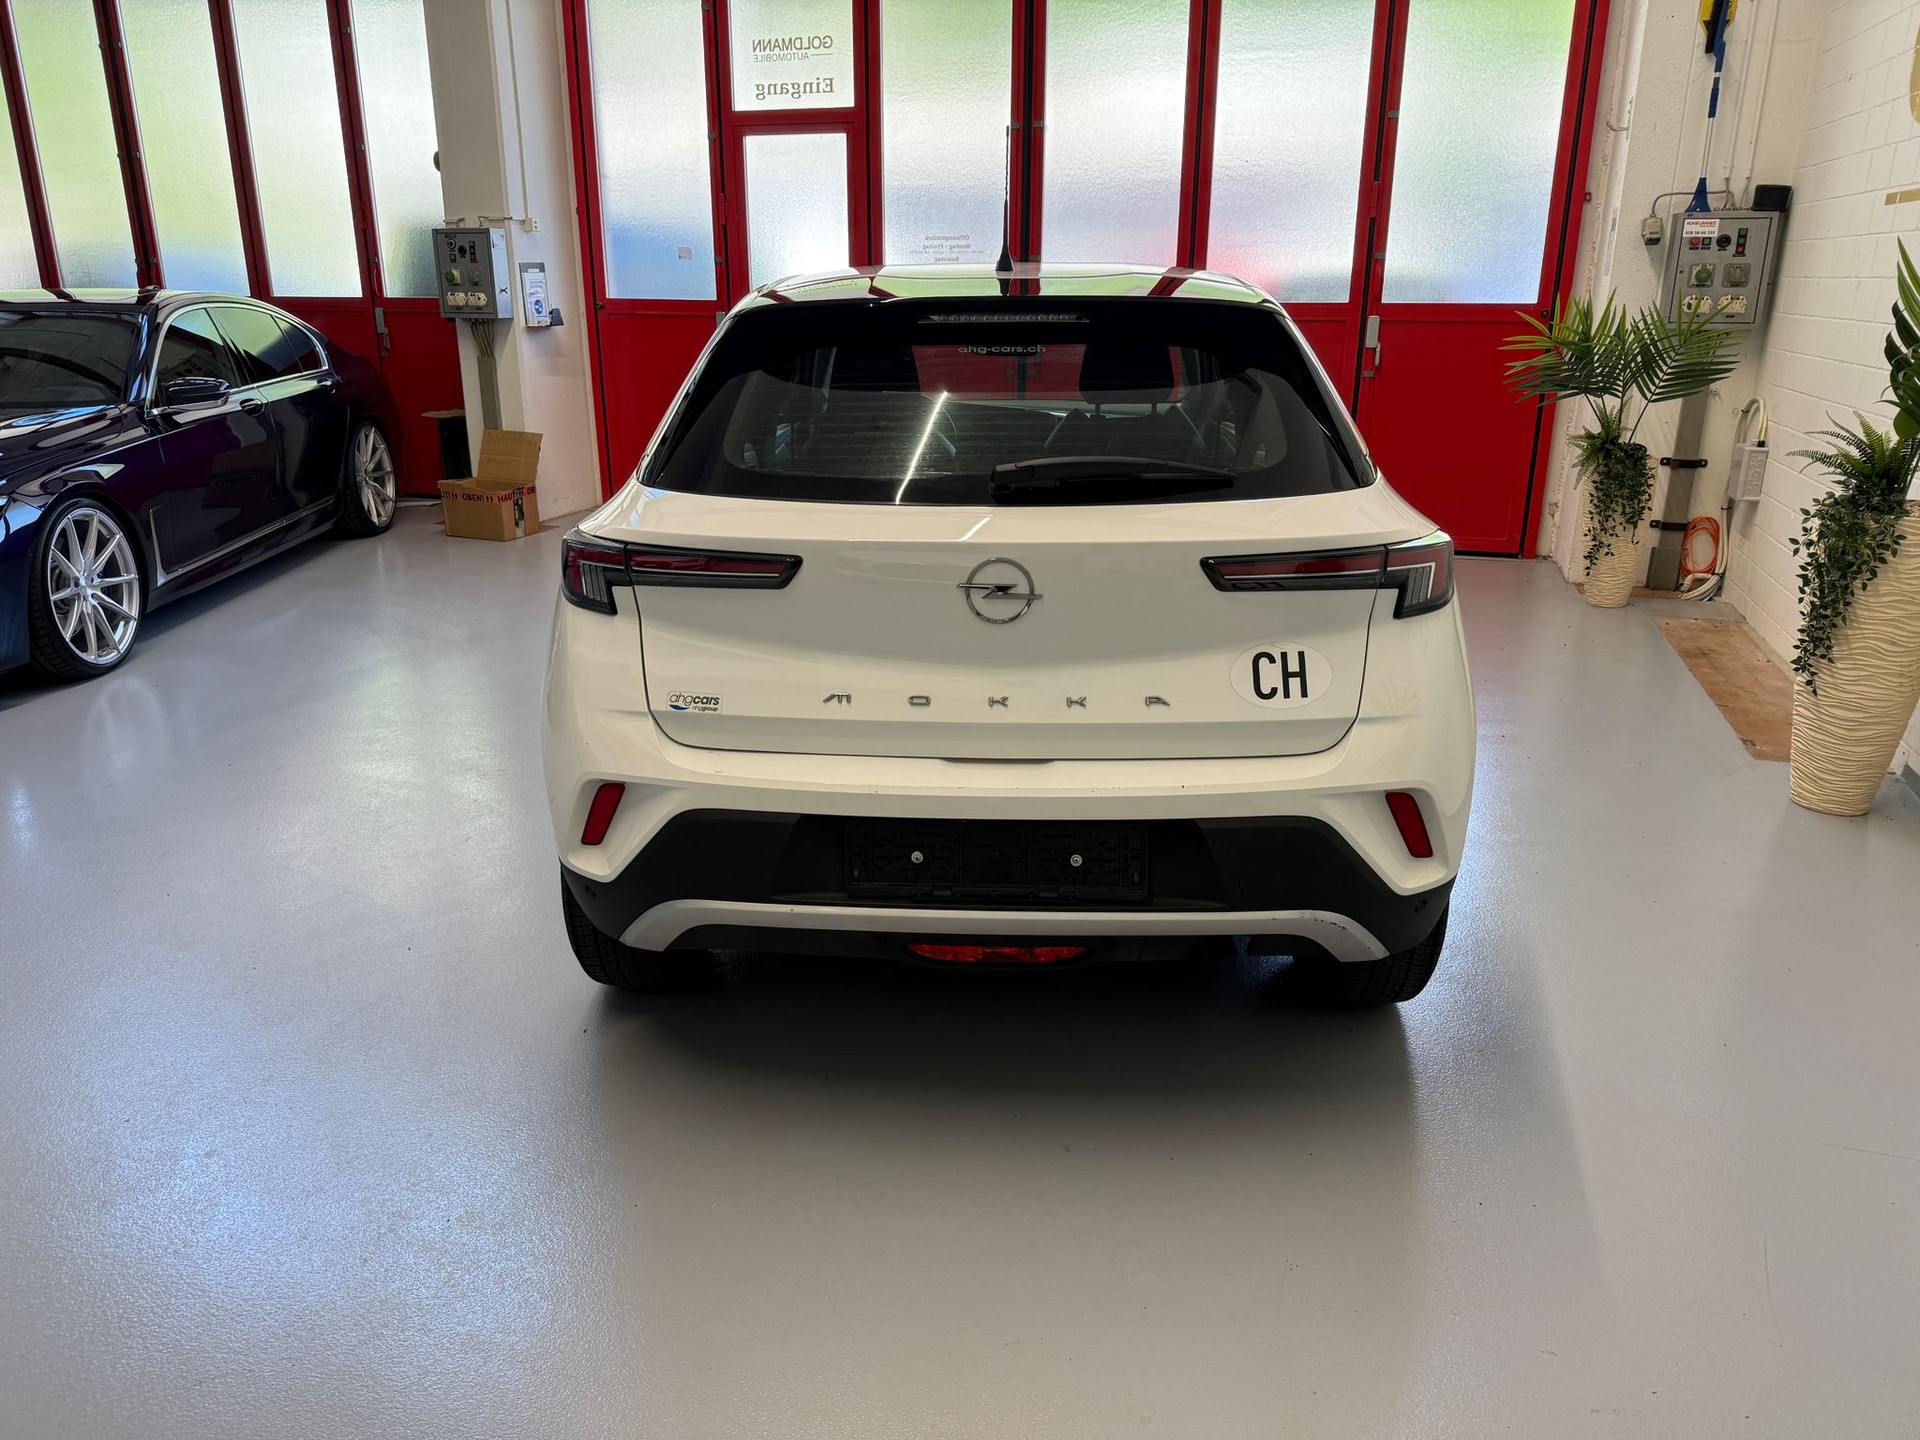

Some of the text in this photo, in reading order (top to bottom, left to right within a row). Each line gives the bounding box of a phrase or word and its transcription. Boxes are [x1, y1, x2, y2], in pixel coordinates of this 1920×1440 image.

[958, 344, 1046, 354] ahg-cars.ch
[1252, 651, 1308, 700] CH
[669, 692, 720, 706] ahgcars
[823, 692, 1171, 707] MOKKA
